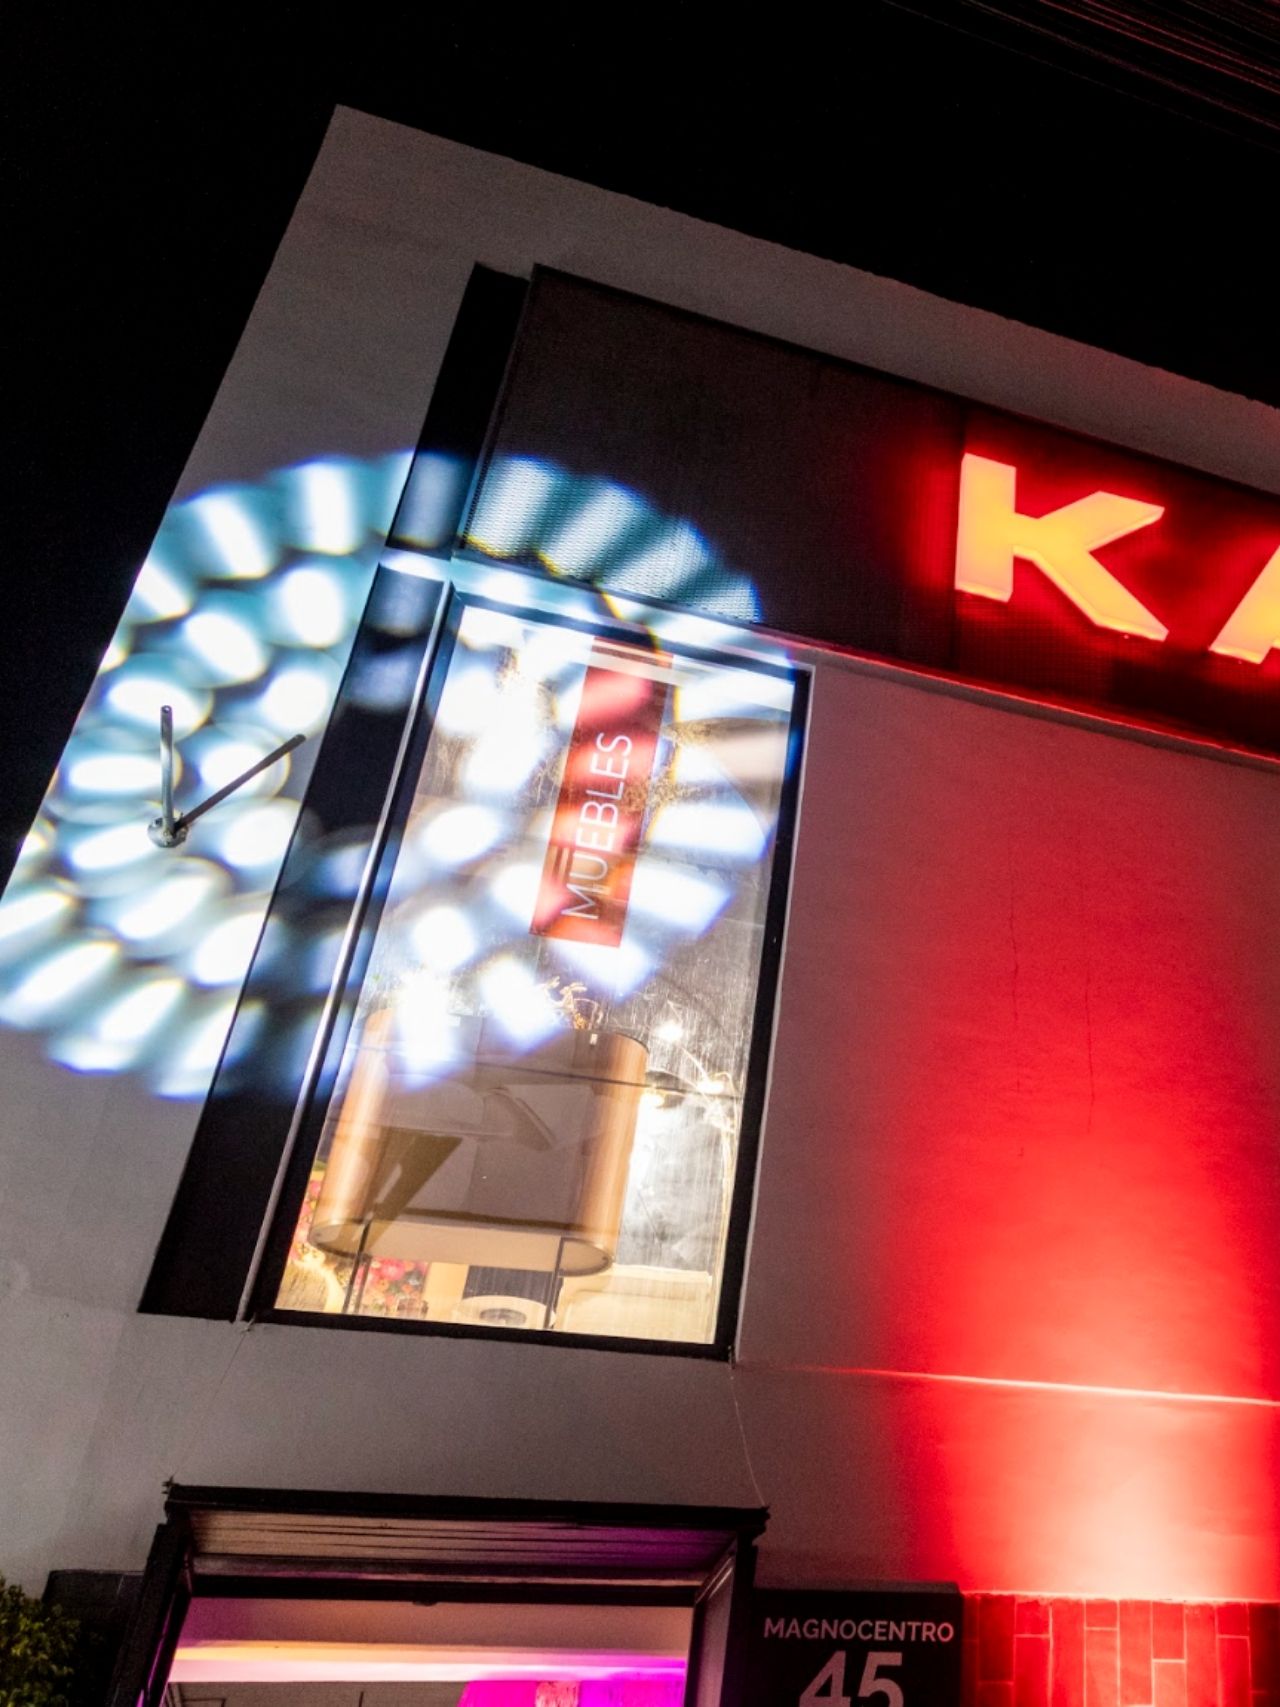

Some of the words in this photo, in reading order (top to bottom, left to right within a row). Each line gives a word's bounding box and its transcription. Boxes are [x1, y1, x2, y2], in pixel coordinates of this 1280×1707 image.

[561, 732, 633, 920] MUEBLES
[764, 1617, 955, 1642] MAGNOCENTRO
[799, 1650, 904, 1707] 45
